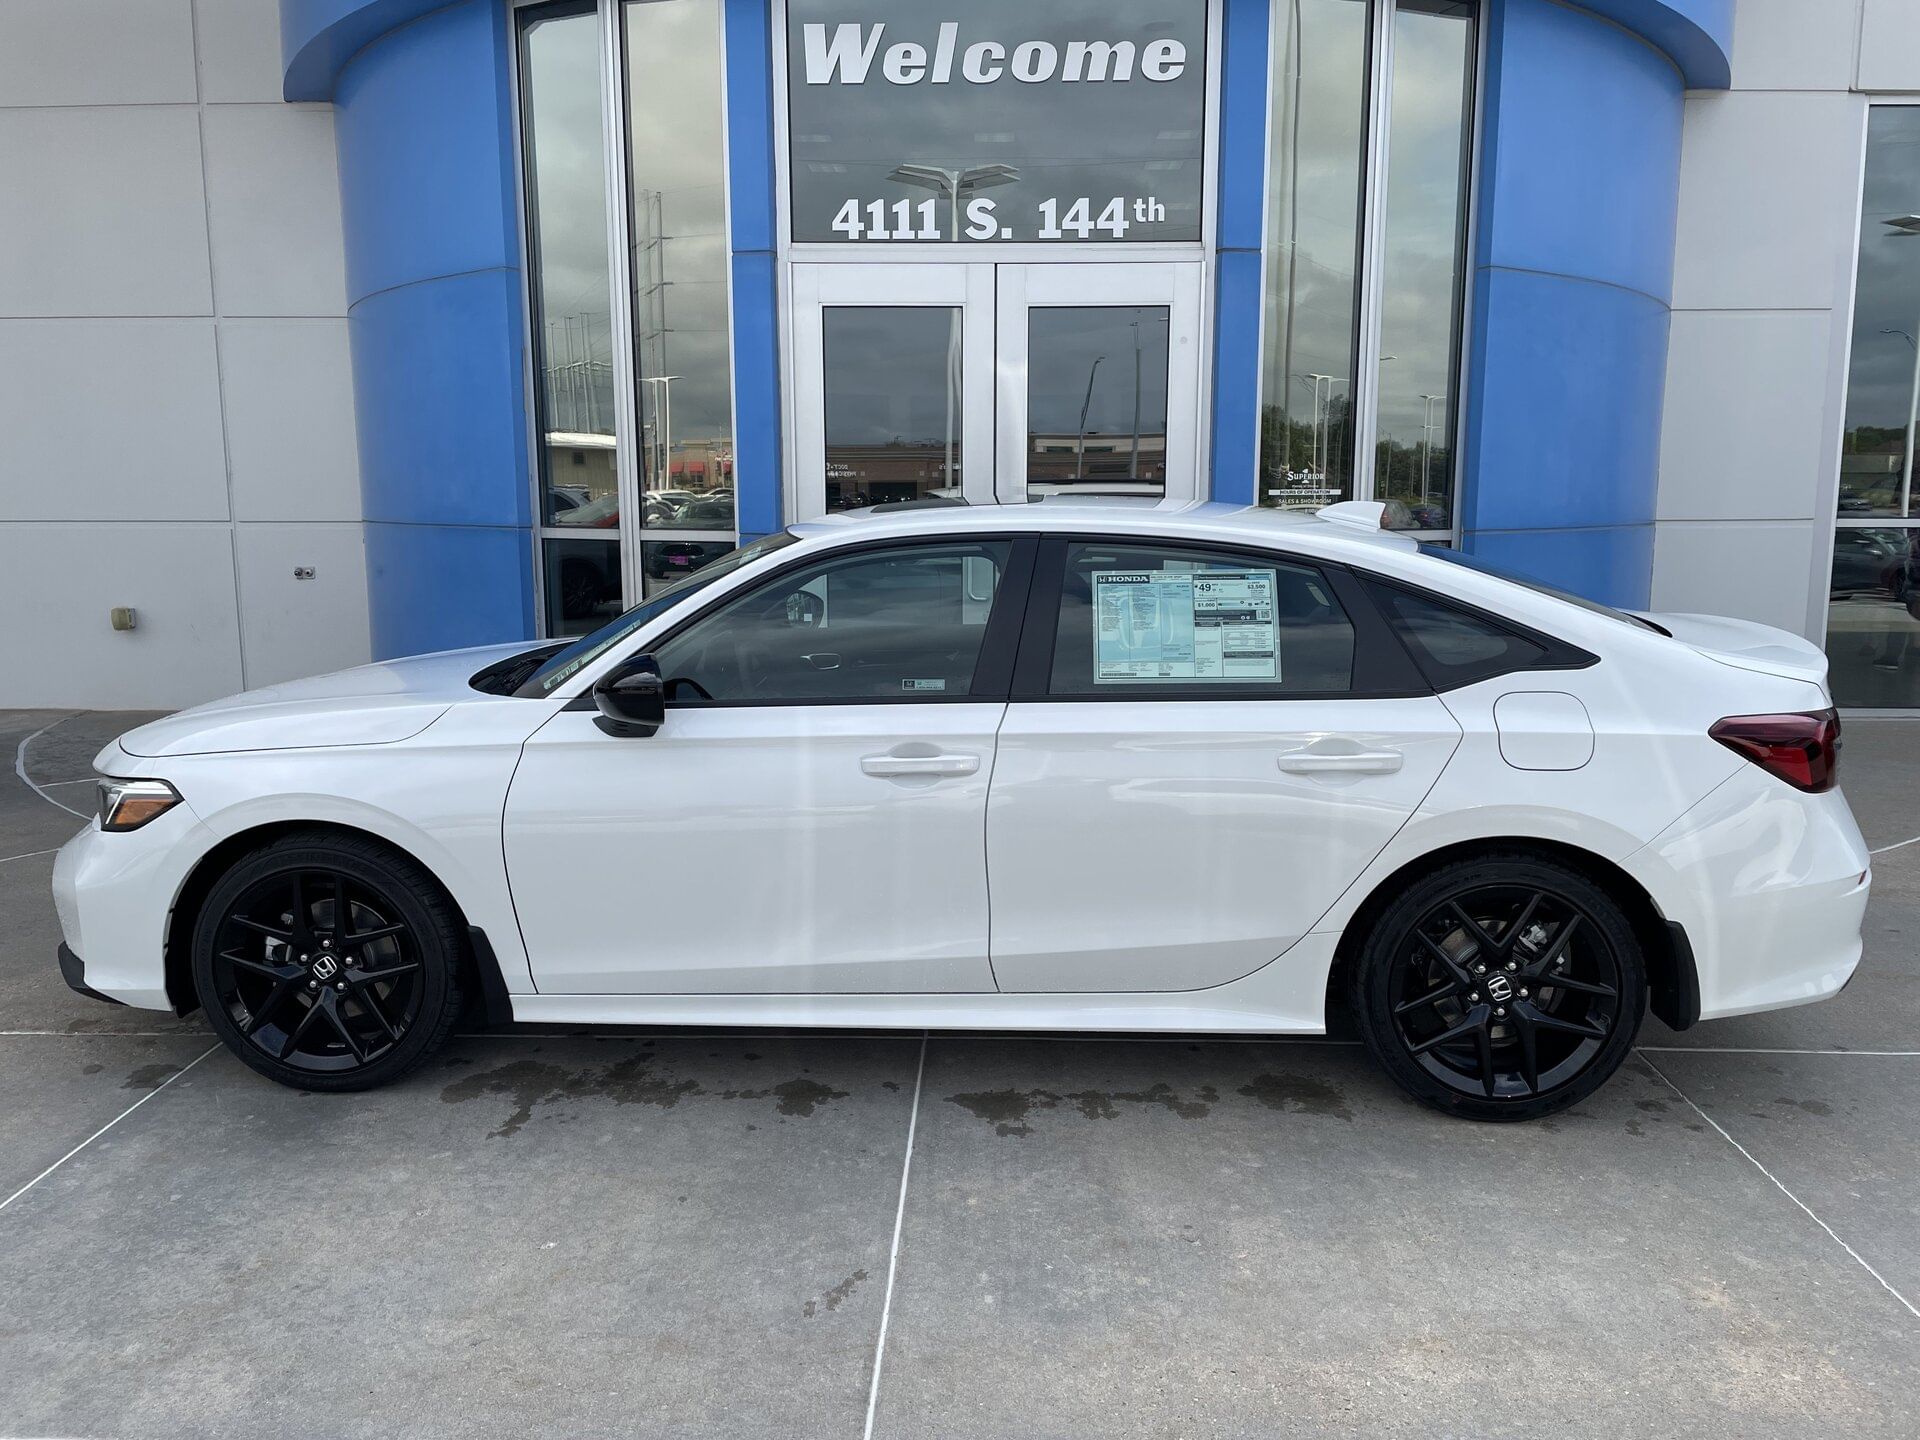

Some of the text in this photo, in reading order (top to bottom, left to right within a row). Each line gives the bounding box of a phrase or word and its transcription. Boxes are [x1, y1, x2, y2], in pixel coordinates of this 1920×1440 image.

[803, 22, 1187, 85] Welcome
[831, 196, 1165, 240] 4111 S. 144th
[1108, 575, 1149, 583] HONDA
[1198, 583, 1212, 592] 49
